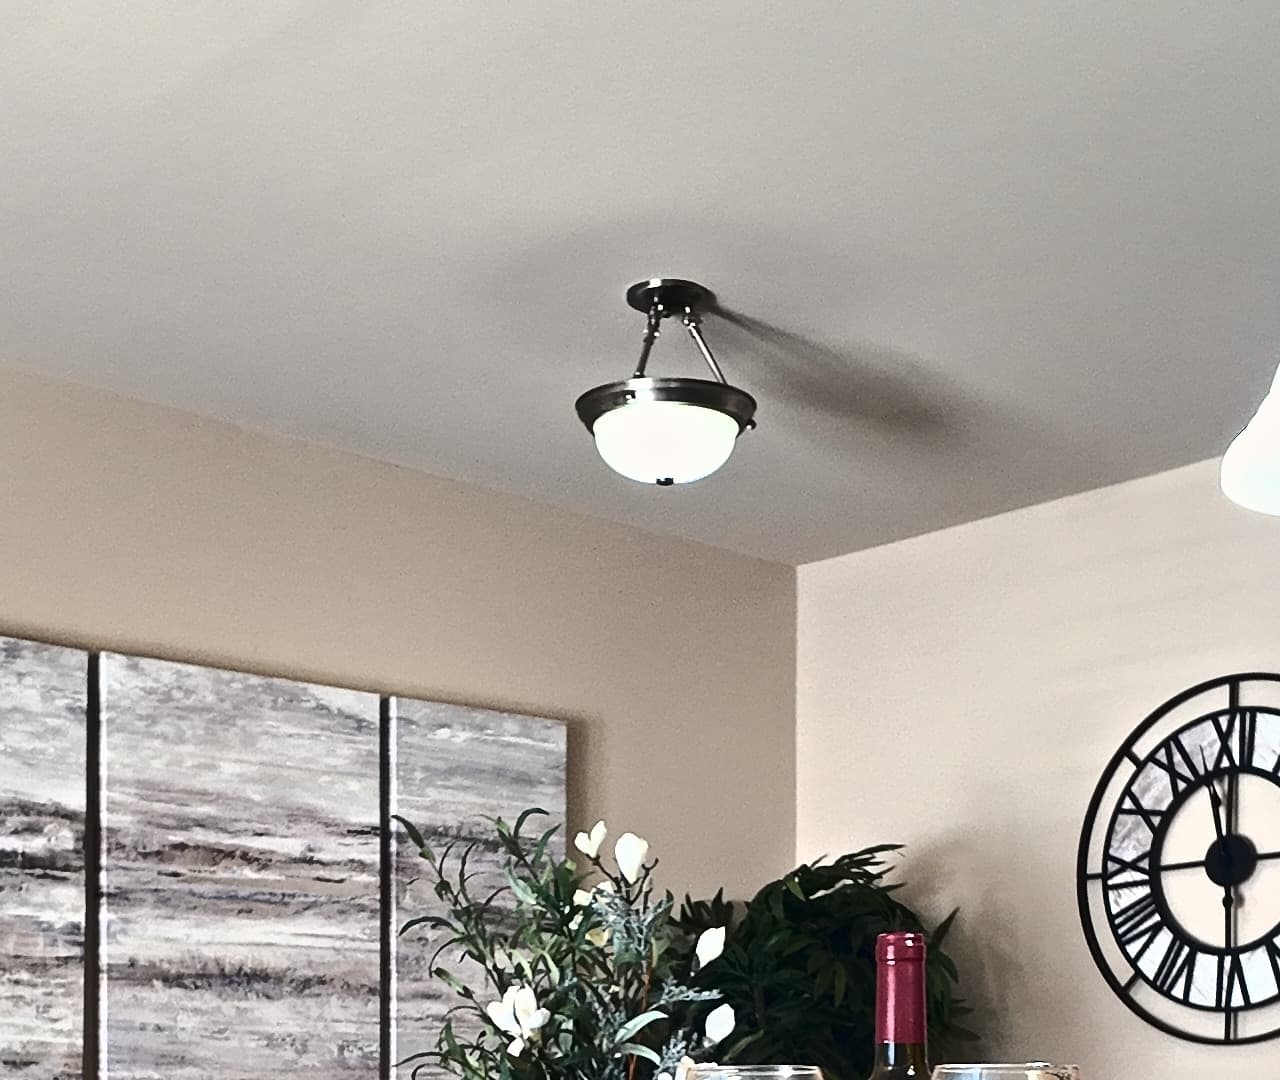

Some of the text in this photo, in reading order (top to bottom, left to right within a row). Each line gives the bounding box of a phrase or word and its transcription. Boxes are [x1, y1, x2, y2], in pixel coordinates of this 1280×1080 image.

[1149, 735, 1200, 798] XI
[1210, 711, 1257, 771] XII
[1118, 788, 1167, 832] X
[1107, 850, 1151, 891] IX
[1112, 892, 1165, 964] VIII
[1152, 936, 1197, 1001] VII
[1215, 953, 1252, 1008] VI
